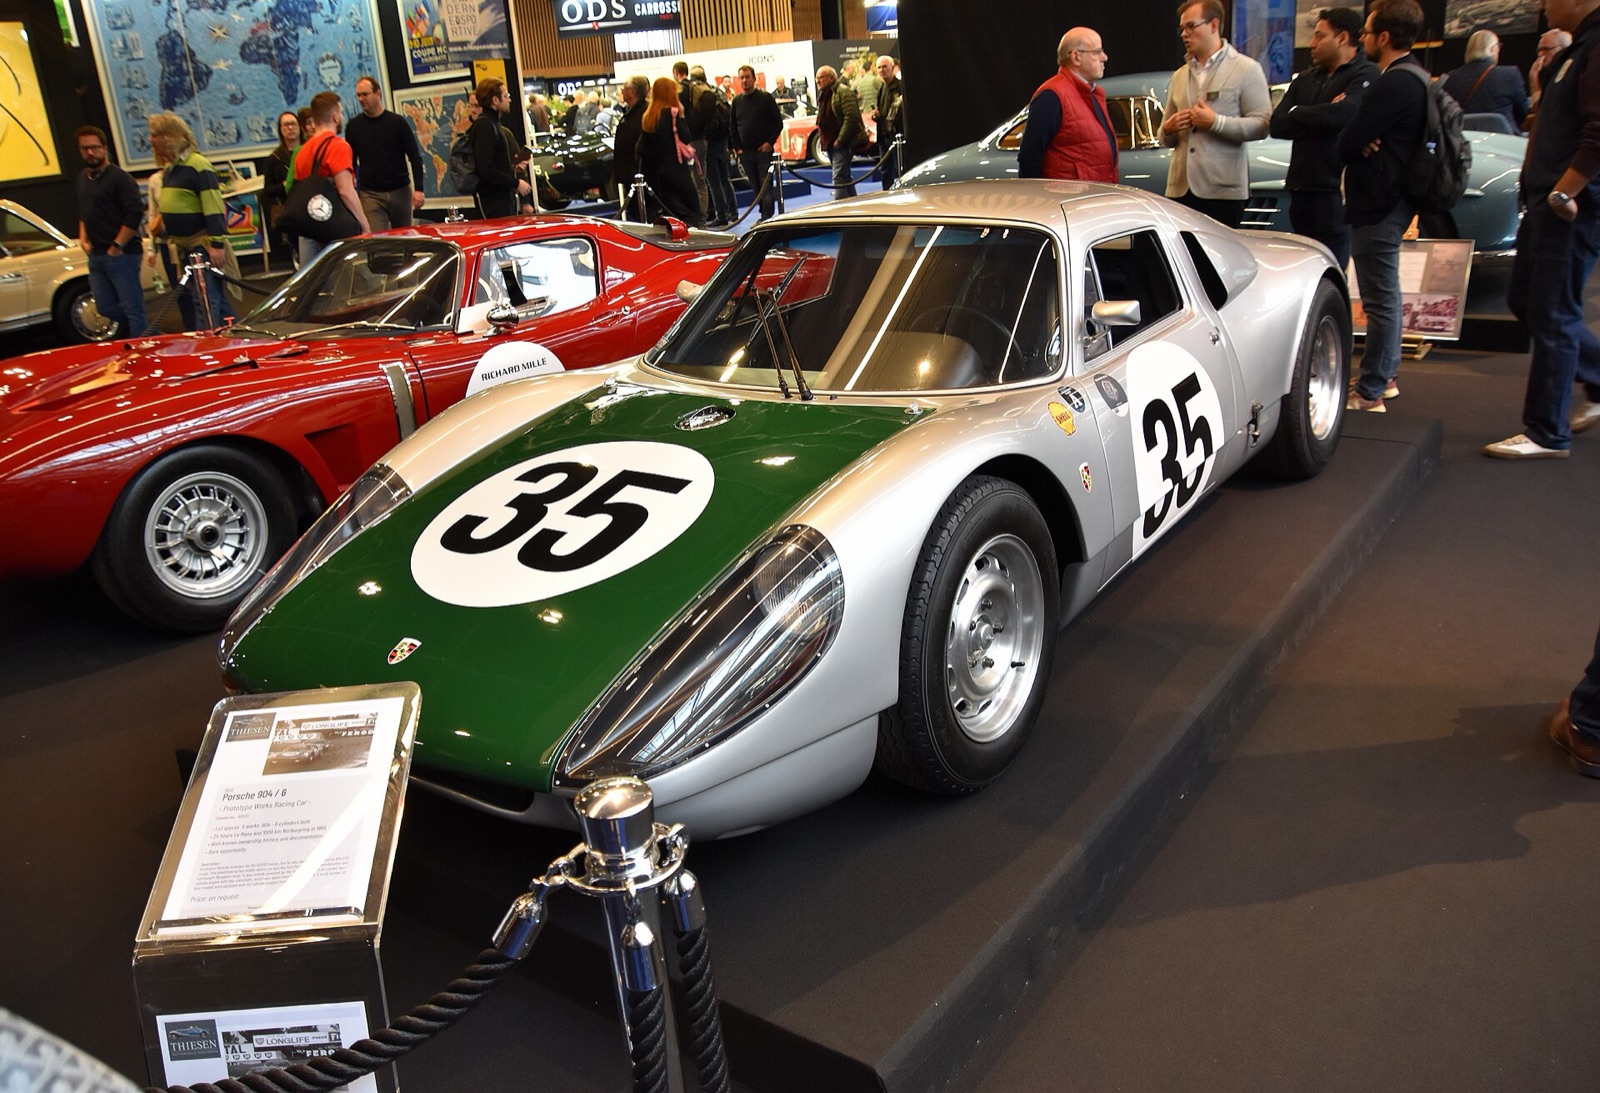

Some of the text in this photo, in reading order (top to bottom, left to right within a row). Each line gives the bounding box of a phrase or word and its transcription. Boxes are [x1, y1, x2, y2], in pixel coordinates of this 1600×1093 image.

[447, 2, 475, 14] DERN
[562, 0, 627, 23] ODS
[748, 54, 775, 65] ICONS
[481, 357, 547, 381] RICHARD MILLE
[1055, 411, 1071, 425] SHELL
[1142, 372, 1213, 539] 35
[440, 461, 693, 572] 35
[311, 720, 350, 729] LONGLIFE
[230, 726, 270, 736] THIESEN
[222, 792, 256, 802] Porsche
[257, 789, 273, 799] 904
[281, 788, 288, 797] 6
[223, 803, 253, 812] Prototype
[254, 802, 273, 810] Works
[190, 895, 207, 903] Price:
[217, 893, 239, 902] request
[170, 1039, 218, 1051] THIESEN
[265, 1036, 310, 1046] LONGLIFE
